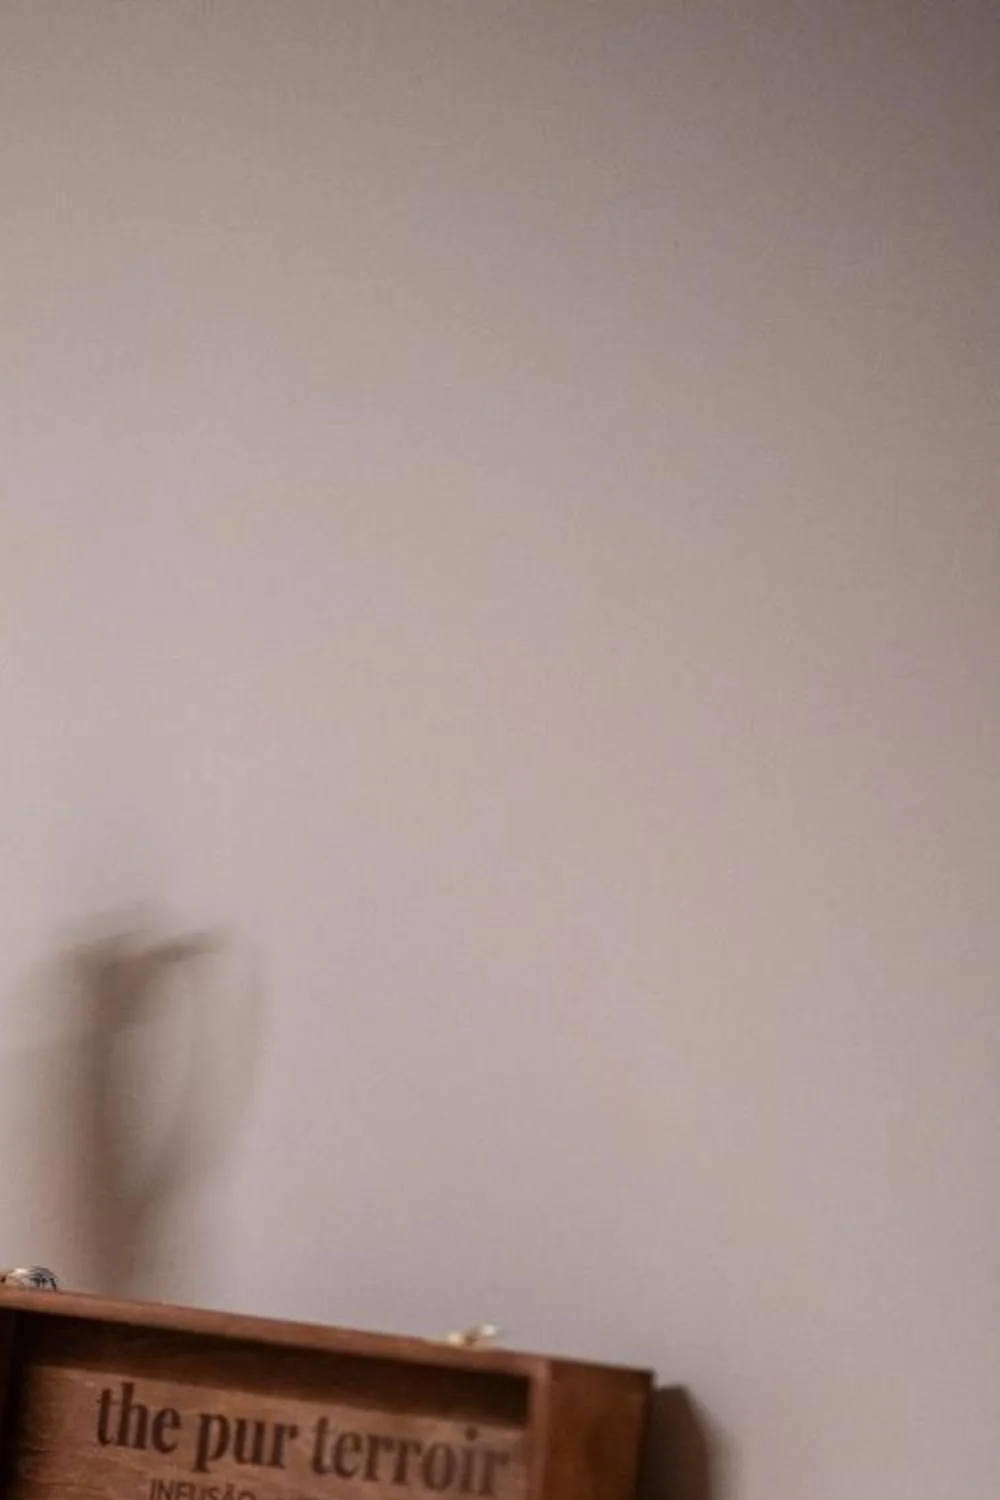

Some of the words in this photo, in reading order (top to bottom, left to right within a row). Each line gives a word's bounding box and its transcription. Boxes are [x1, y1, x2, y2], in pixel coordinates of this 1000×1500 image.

[96, 1381, 182, 1454] the
[193, 1410, 298, 1474] pur
[310, 1415, 510, 1498] terroir
